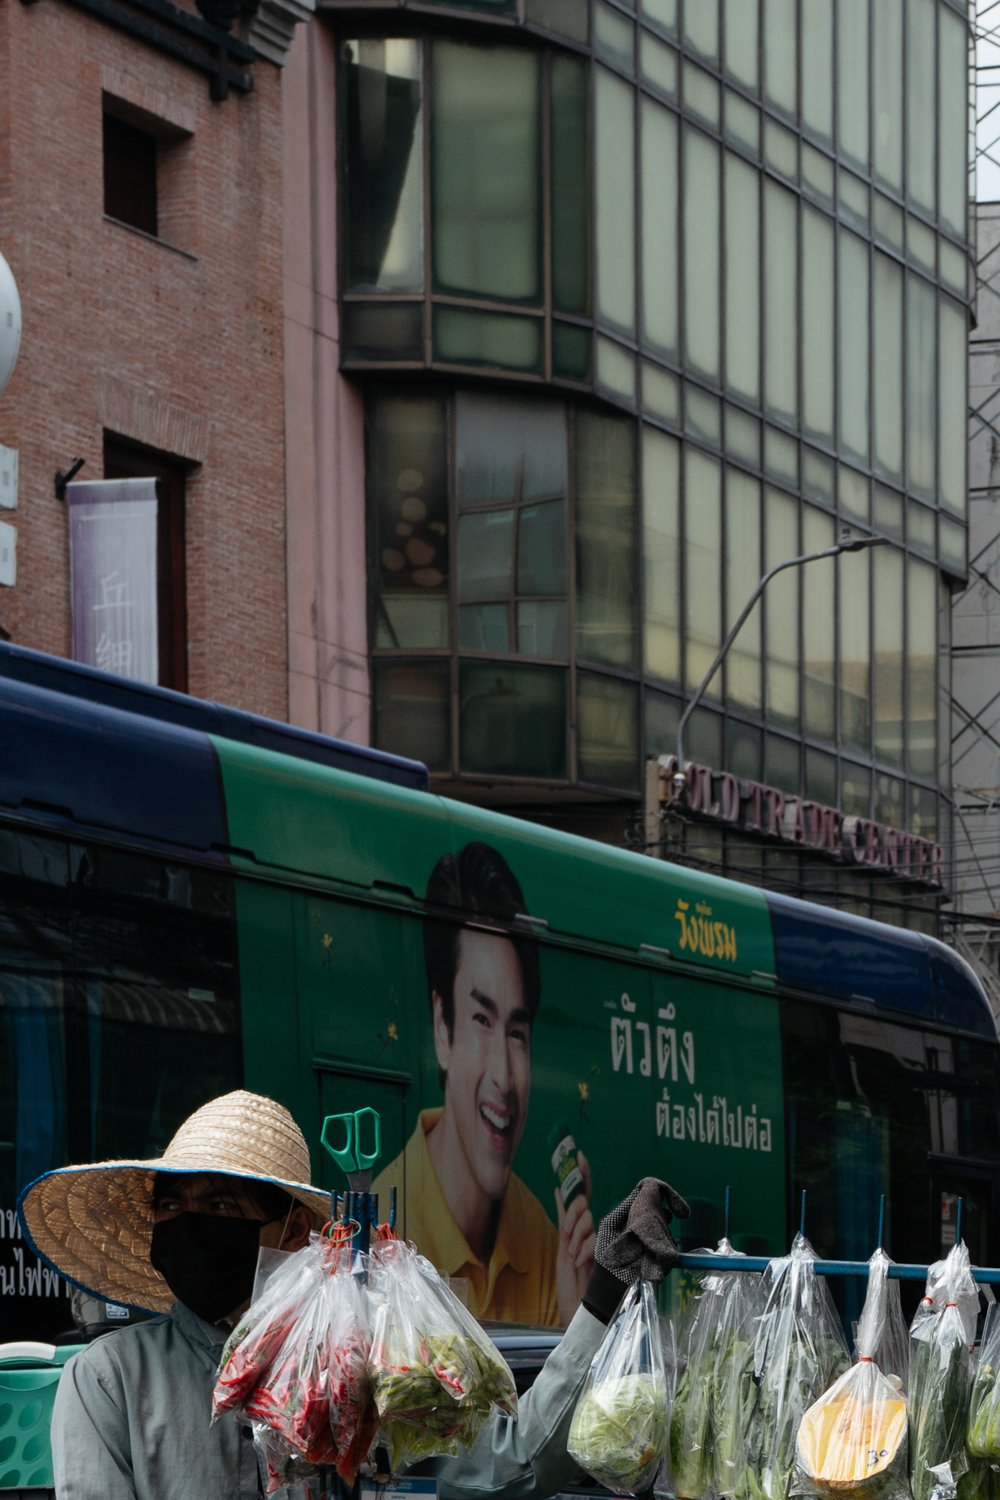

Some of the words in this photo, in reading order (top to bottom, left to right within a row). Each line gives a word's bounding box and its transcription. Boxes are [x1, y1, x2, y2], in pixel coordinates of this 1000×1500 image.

[746, 780, 842, 858] TRADE
[842, 815, 945, 888] CENTER
[655, 1087, 773, 1153] ต้องได้ไปต่อ
